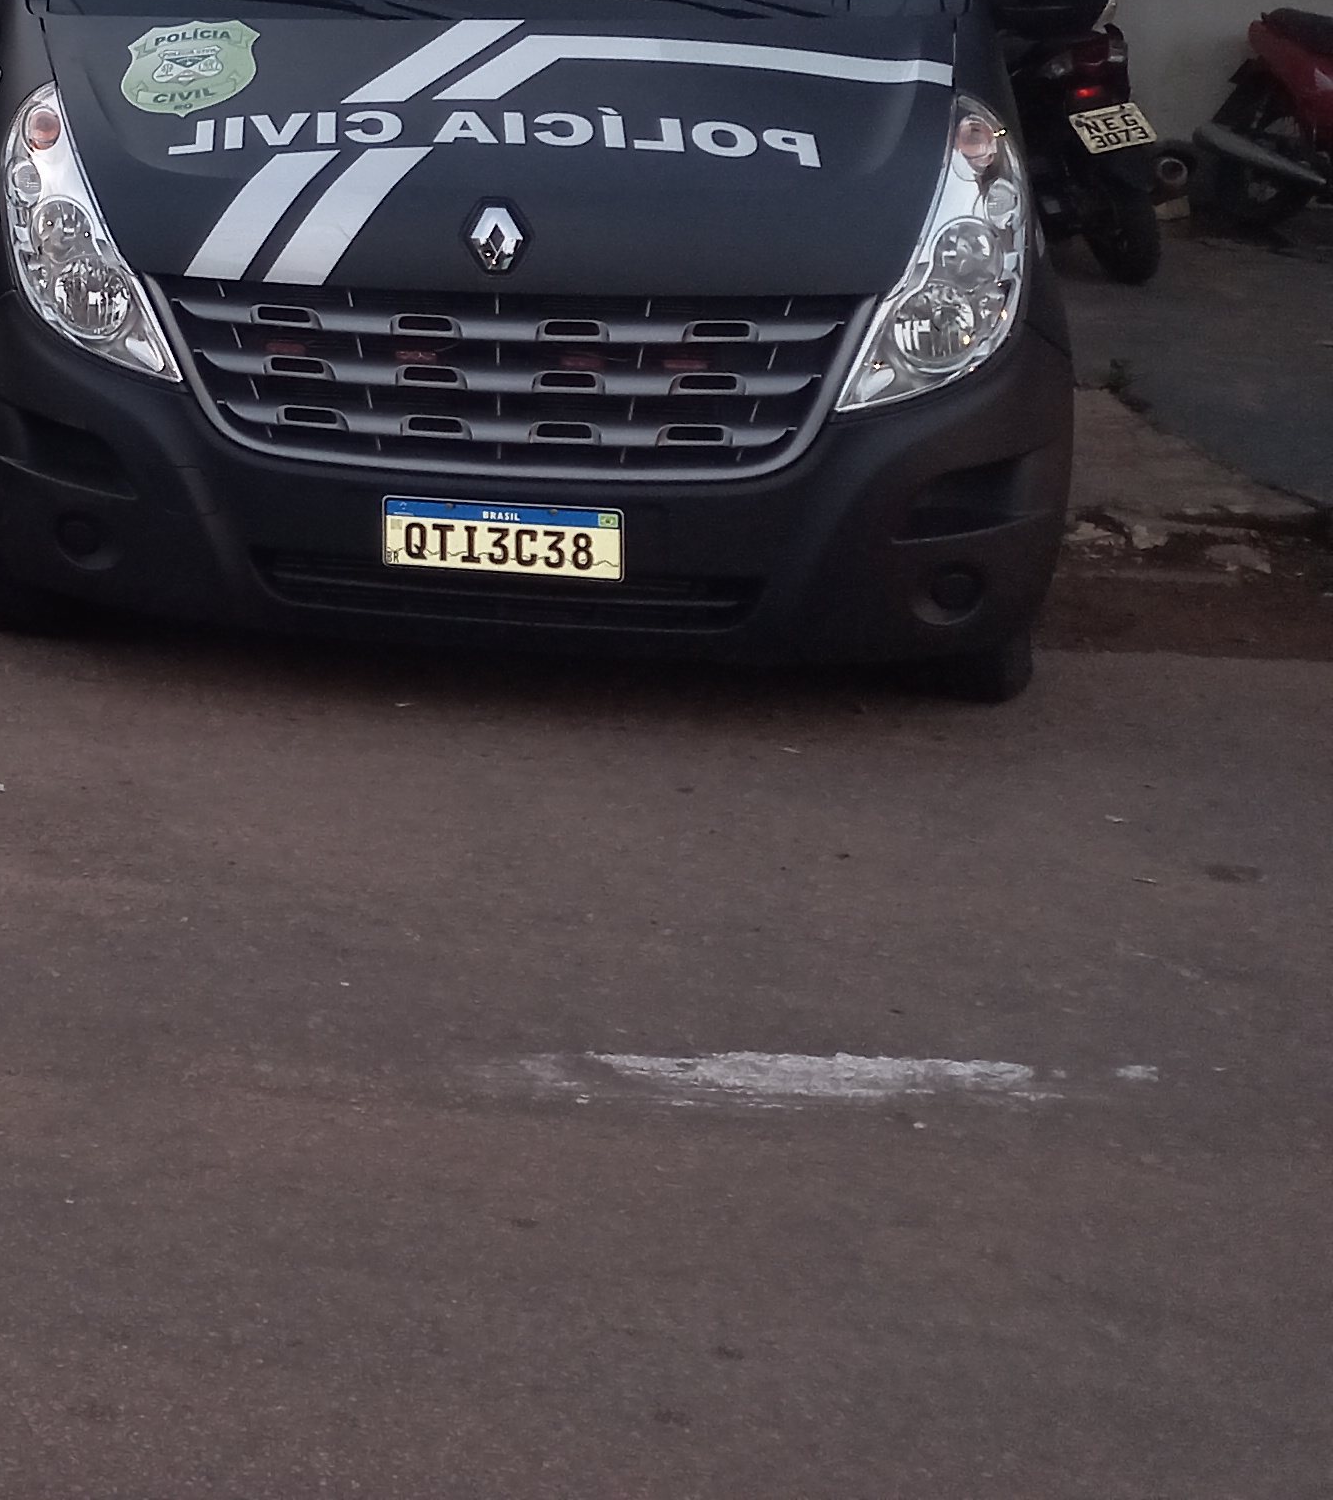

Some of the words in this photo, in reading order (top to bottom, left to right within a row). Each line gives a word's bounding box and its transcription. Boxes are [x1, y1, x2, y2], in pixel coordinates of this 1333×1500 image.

[154, 27, 232, 47] POLÍCIA
[152, 87, 217, 104] CIVIL
[1084, 113, 1138, 134] NEG
[1090, 126, 1149, 148] 3073
[482, 510, 521, 522] BRASIL
[404, 521, 595, 571] QTI3C38
